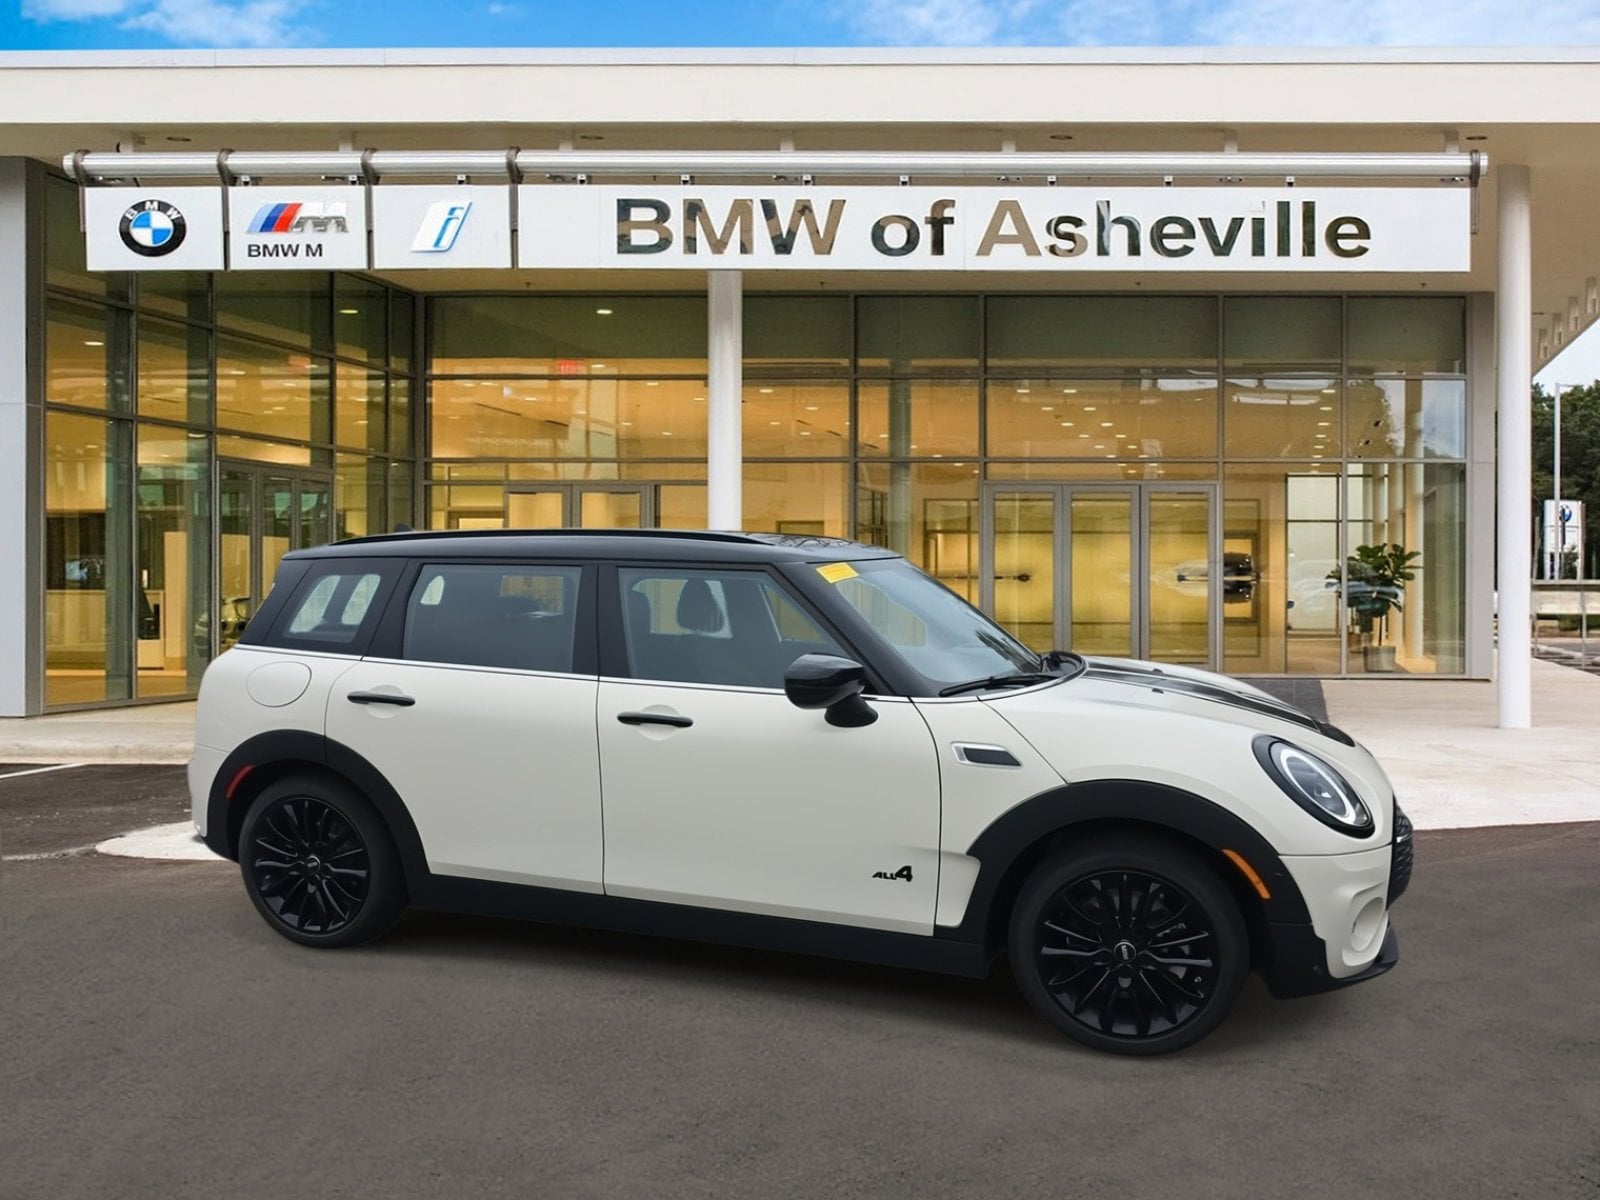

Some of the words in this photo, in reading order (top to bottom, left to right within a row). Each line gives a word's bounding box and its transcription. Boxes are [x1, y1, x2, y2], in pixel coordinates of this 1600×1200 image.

[125, 200, 181, 220] BMW
[616, 198, 847, 256] BMW
[870, 199, 956, 257] of
[975, 199, 1372, 258] Asheville
[247, 243, 300, 258] BMW
[305, 243, 323, 257] M
